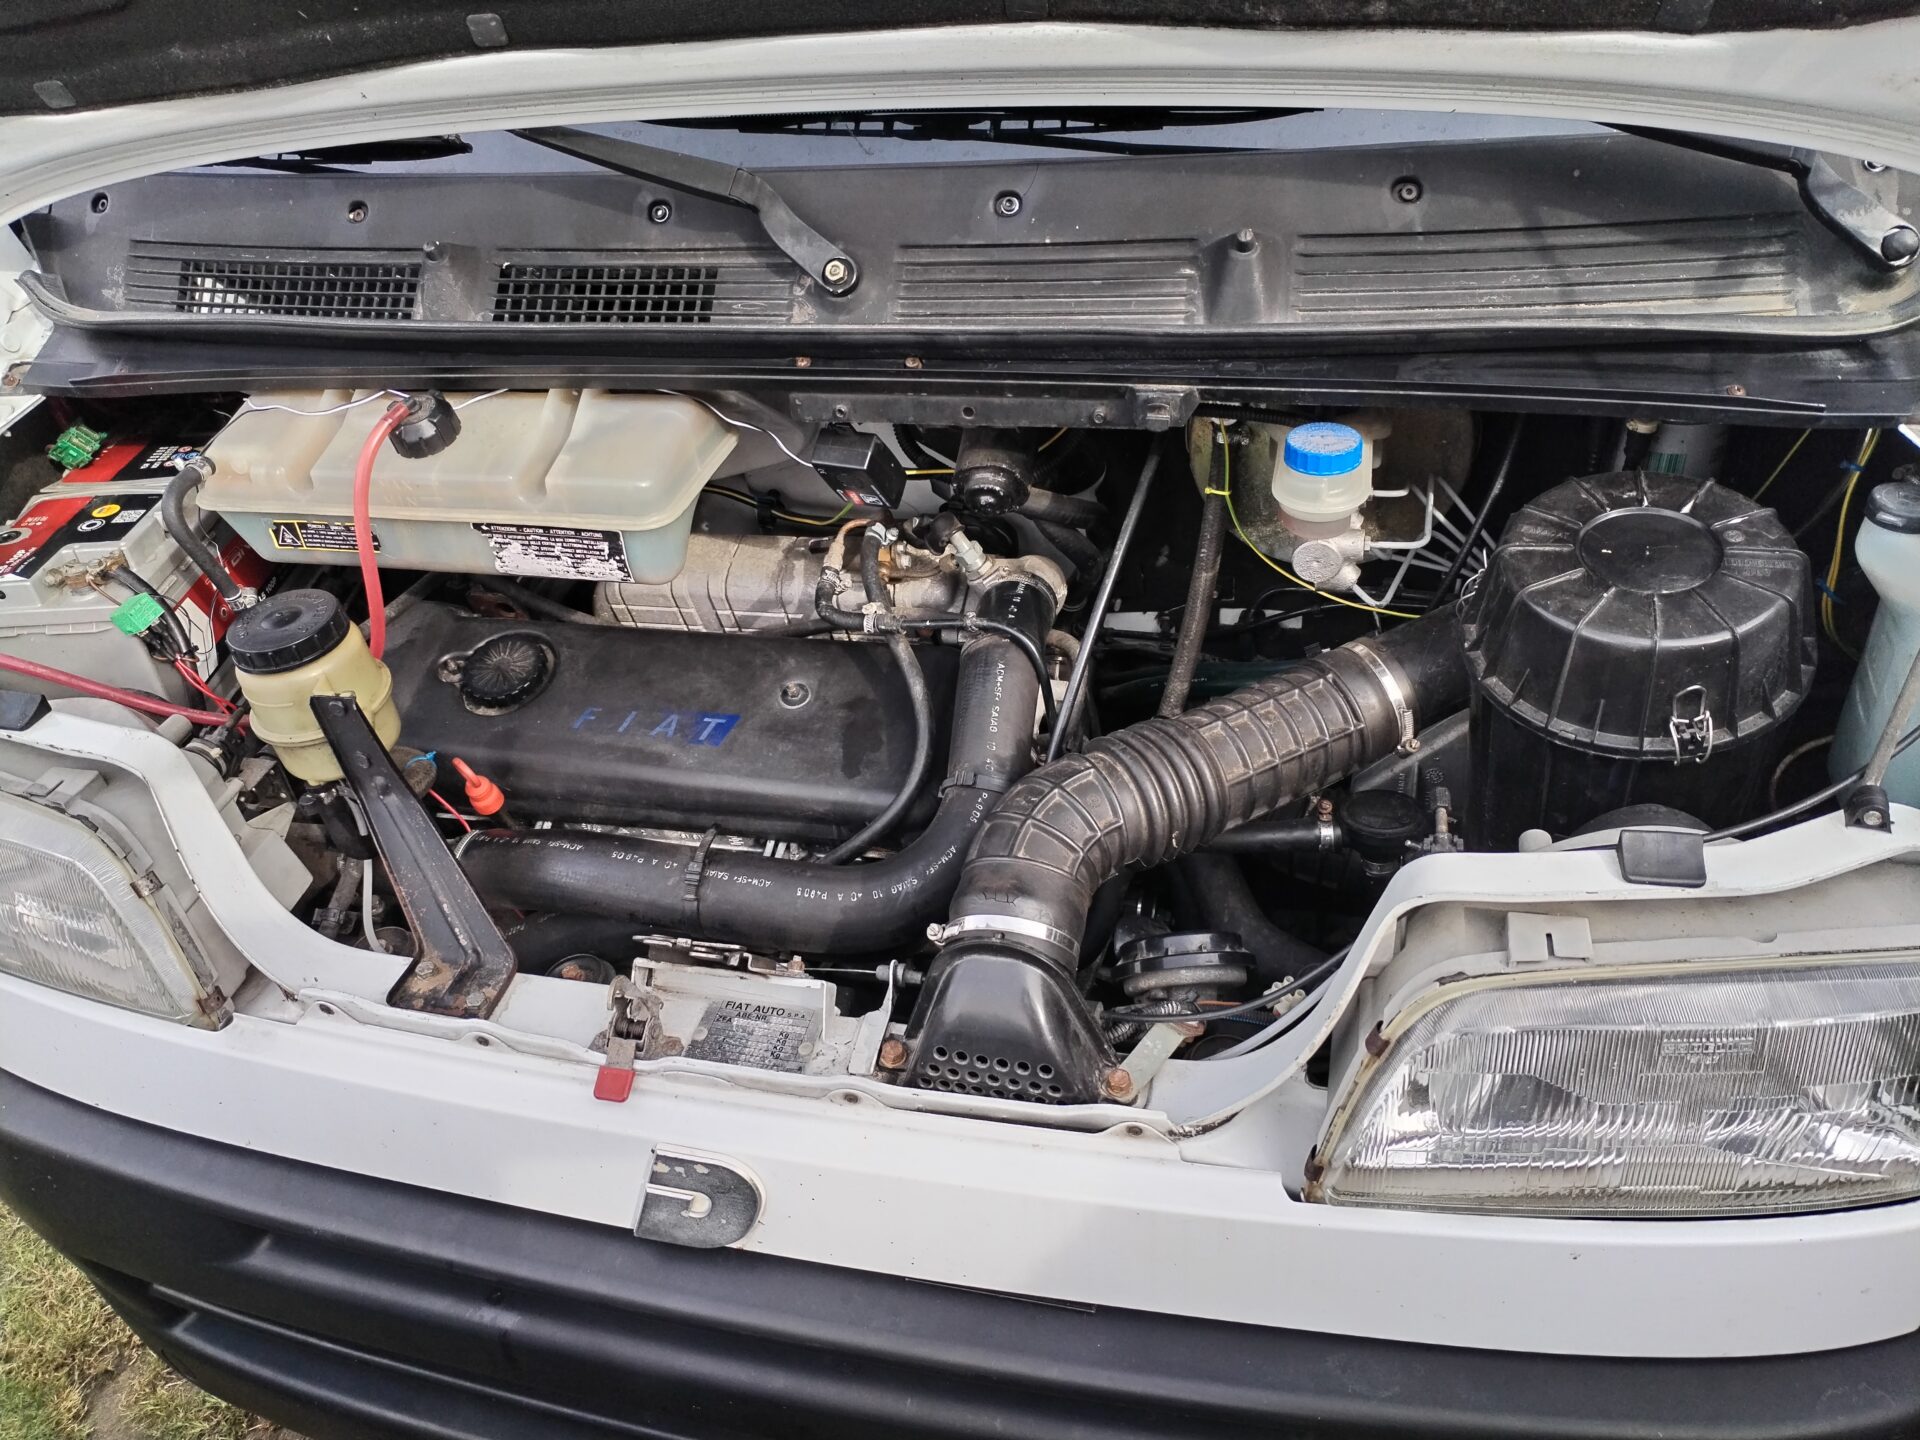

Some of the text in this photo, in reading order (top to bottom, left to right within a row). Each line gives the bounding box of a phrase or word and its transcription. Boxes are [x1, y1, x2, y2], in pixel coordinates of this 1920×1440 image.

[572, 706, 727, 742] FIAT
[725, 1000, 752, 1011] FIAT
[753, 1004, 786, 1017] AUTO
[716, 1014, 732, 1024] ZFA
